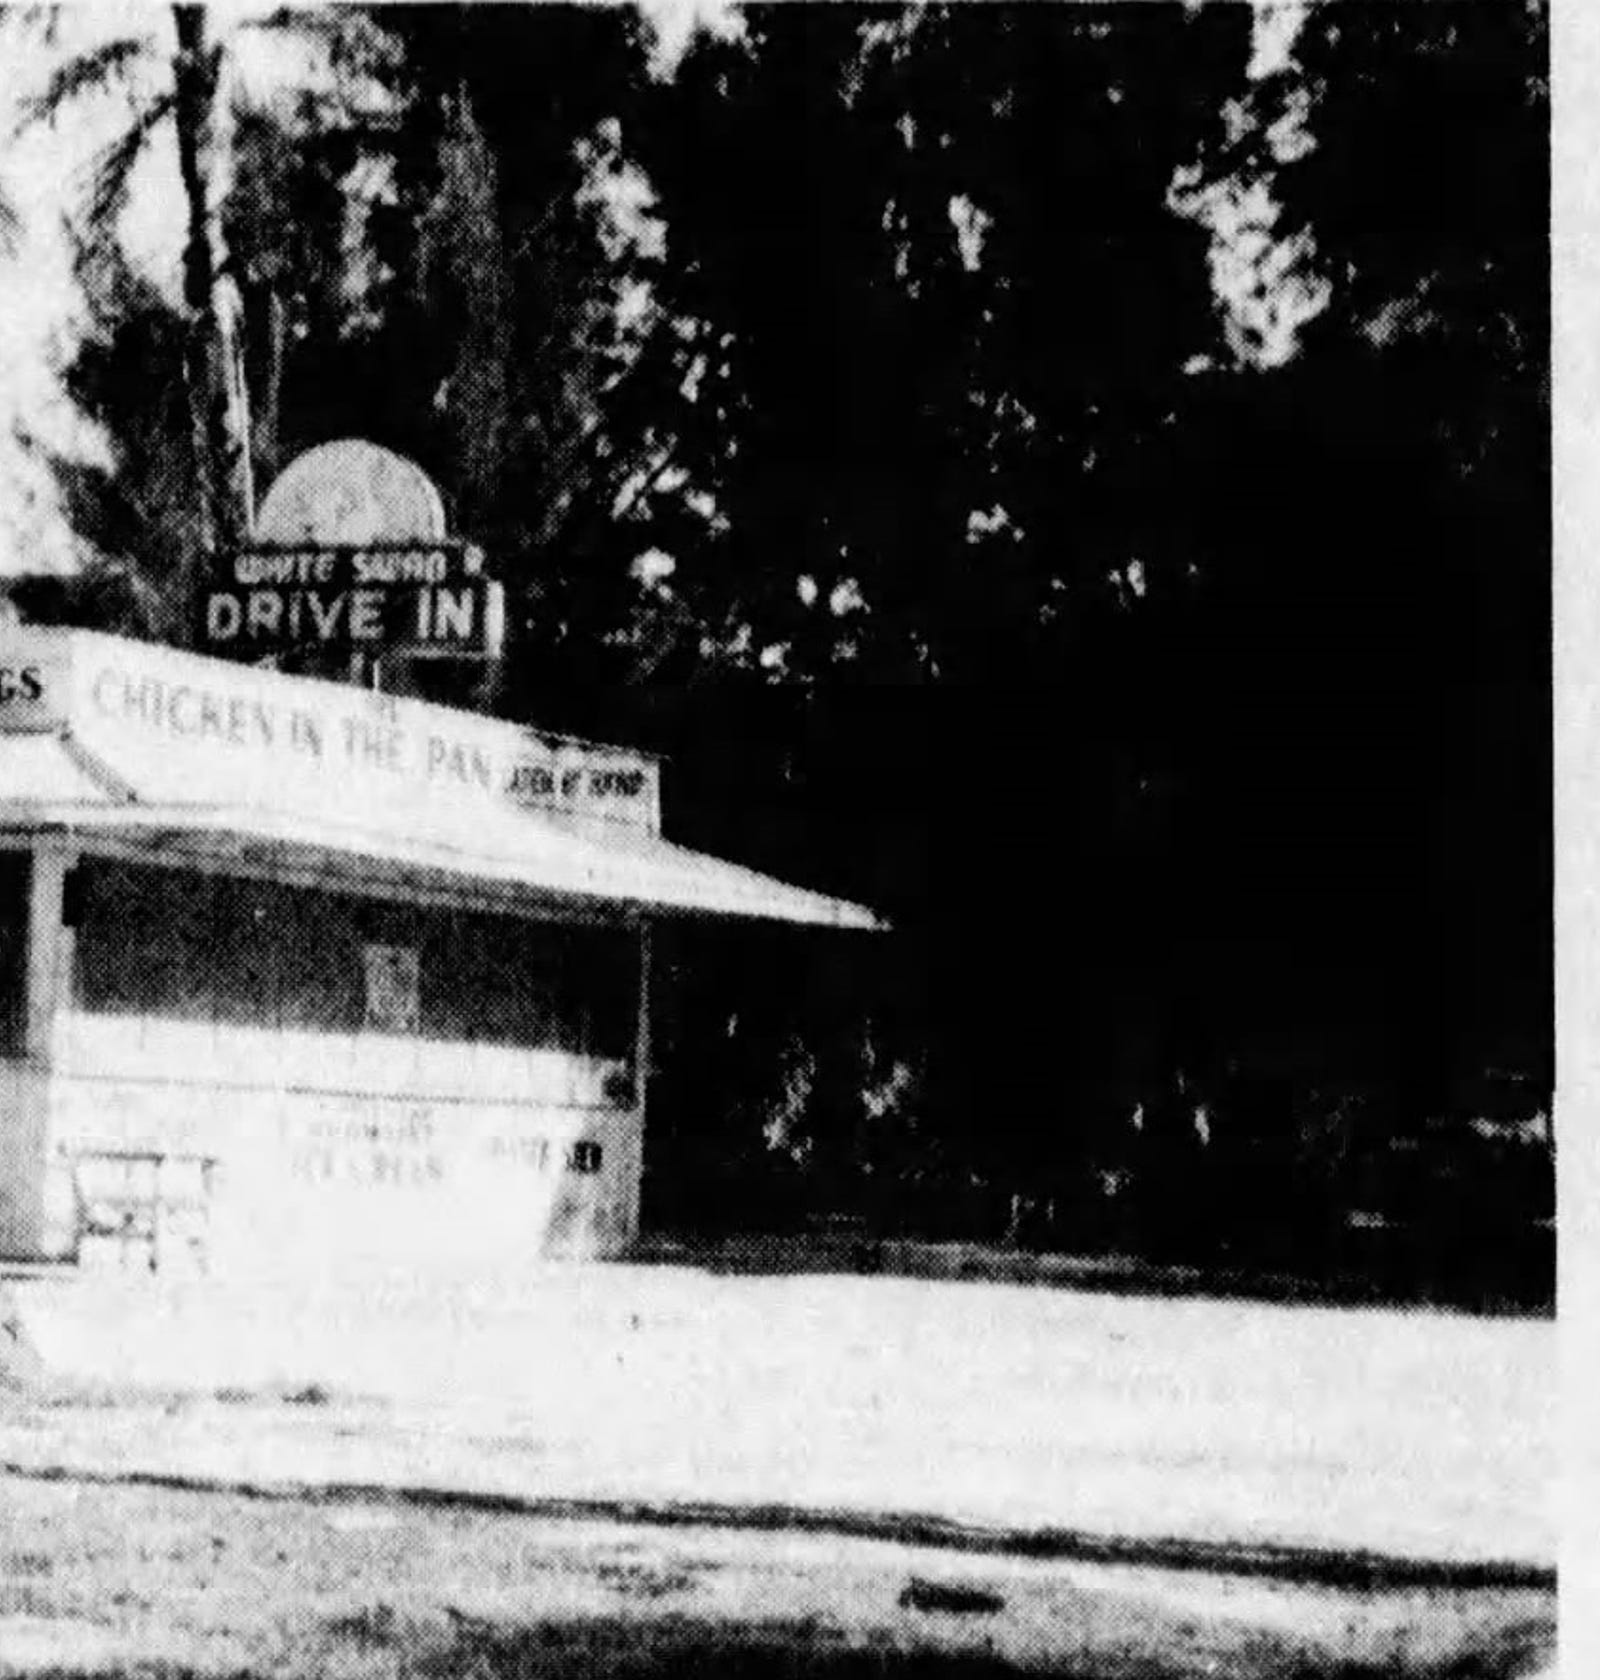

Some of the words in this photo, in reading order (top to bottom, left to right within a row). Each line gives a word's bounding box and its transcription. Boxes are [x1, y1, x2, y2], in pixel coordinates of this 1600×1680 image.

[206, 590, 387, 641] DRIVE
[416, 587, 475, 640] IN
[92, 665, 276, 746] CHICKEN
[289, 707, 323, 758] IN
[341, 713, 406, 773] THE
[427, 734, 493, 790] PAN
